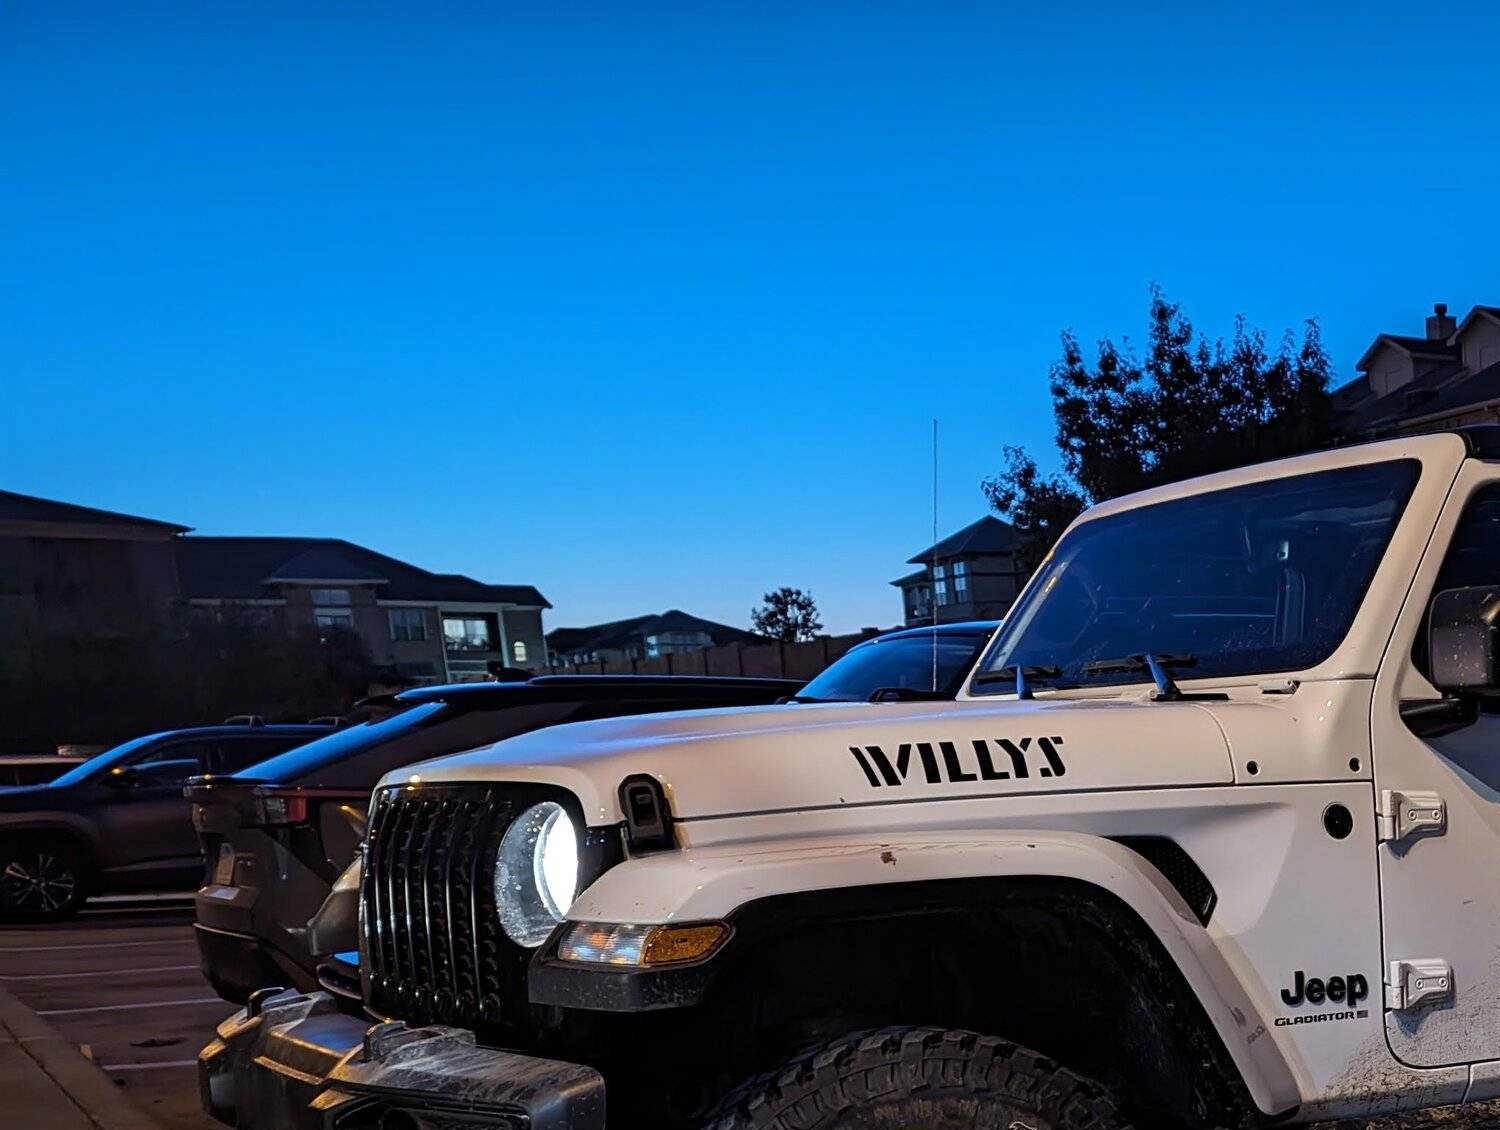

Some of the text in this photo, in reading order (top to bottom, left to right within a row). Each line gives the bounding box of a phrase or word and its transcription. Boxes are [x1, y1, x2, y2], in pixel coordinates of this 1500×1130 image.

[849, 736, 1065, 787] WILLYS
[1280, 970, 1369, 1008] Jeep
[1274, 1011, 1355, 1027] GLADIATOR
